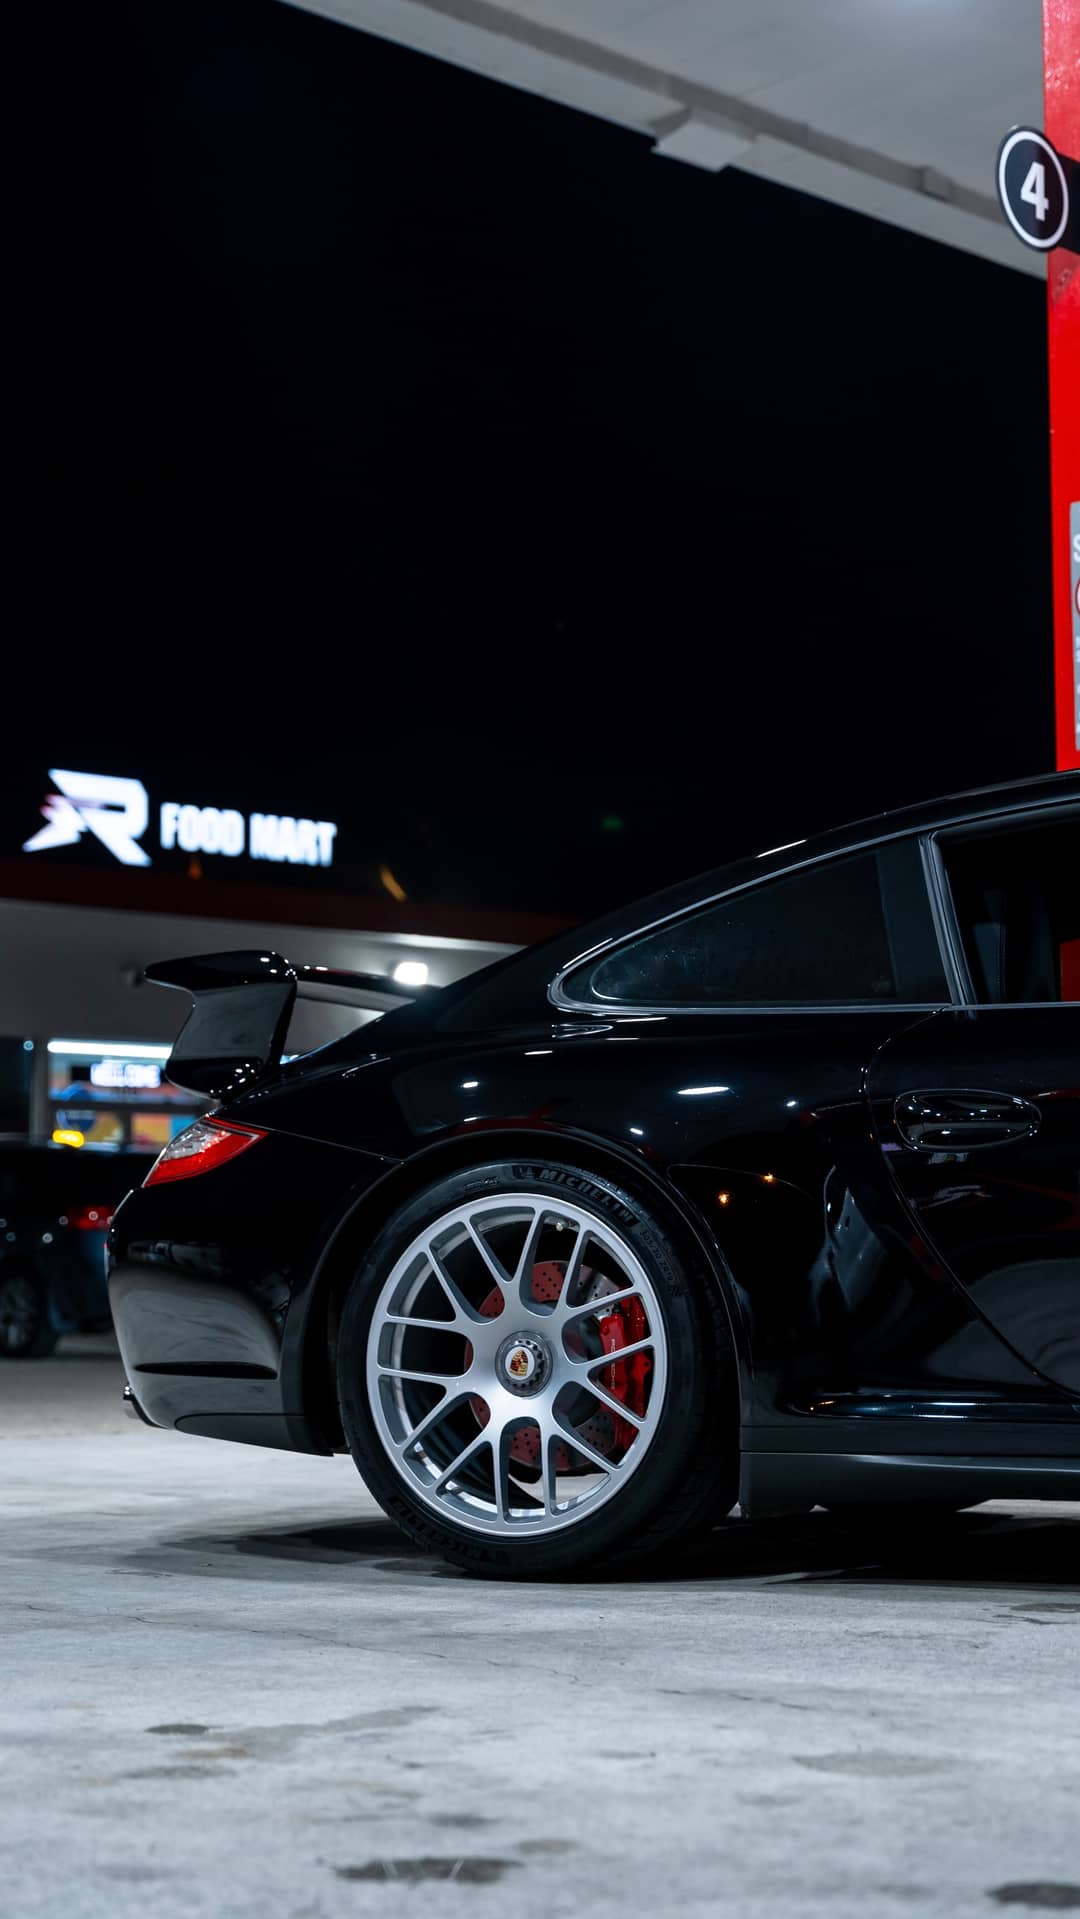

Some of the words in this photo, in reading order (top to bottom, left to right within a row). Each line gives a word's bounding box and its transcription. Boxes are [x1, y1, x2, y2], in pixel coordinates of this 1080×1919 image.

[1020, 161, 1050, 222] 4
[161, 803, 244, 856] FOOD
[250, 812, 337, 866] MART
[539, 1166, 636, 1224] MICHELIN
